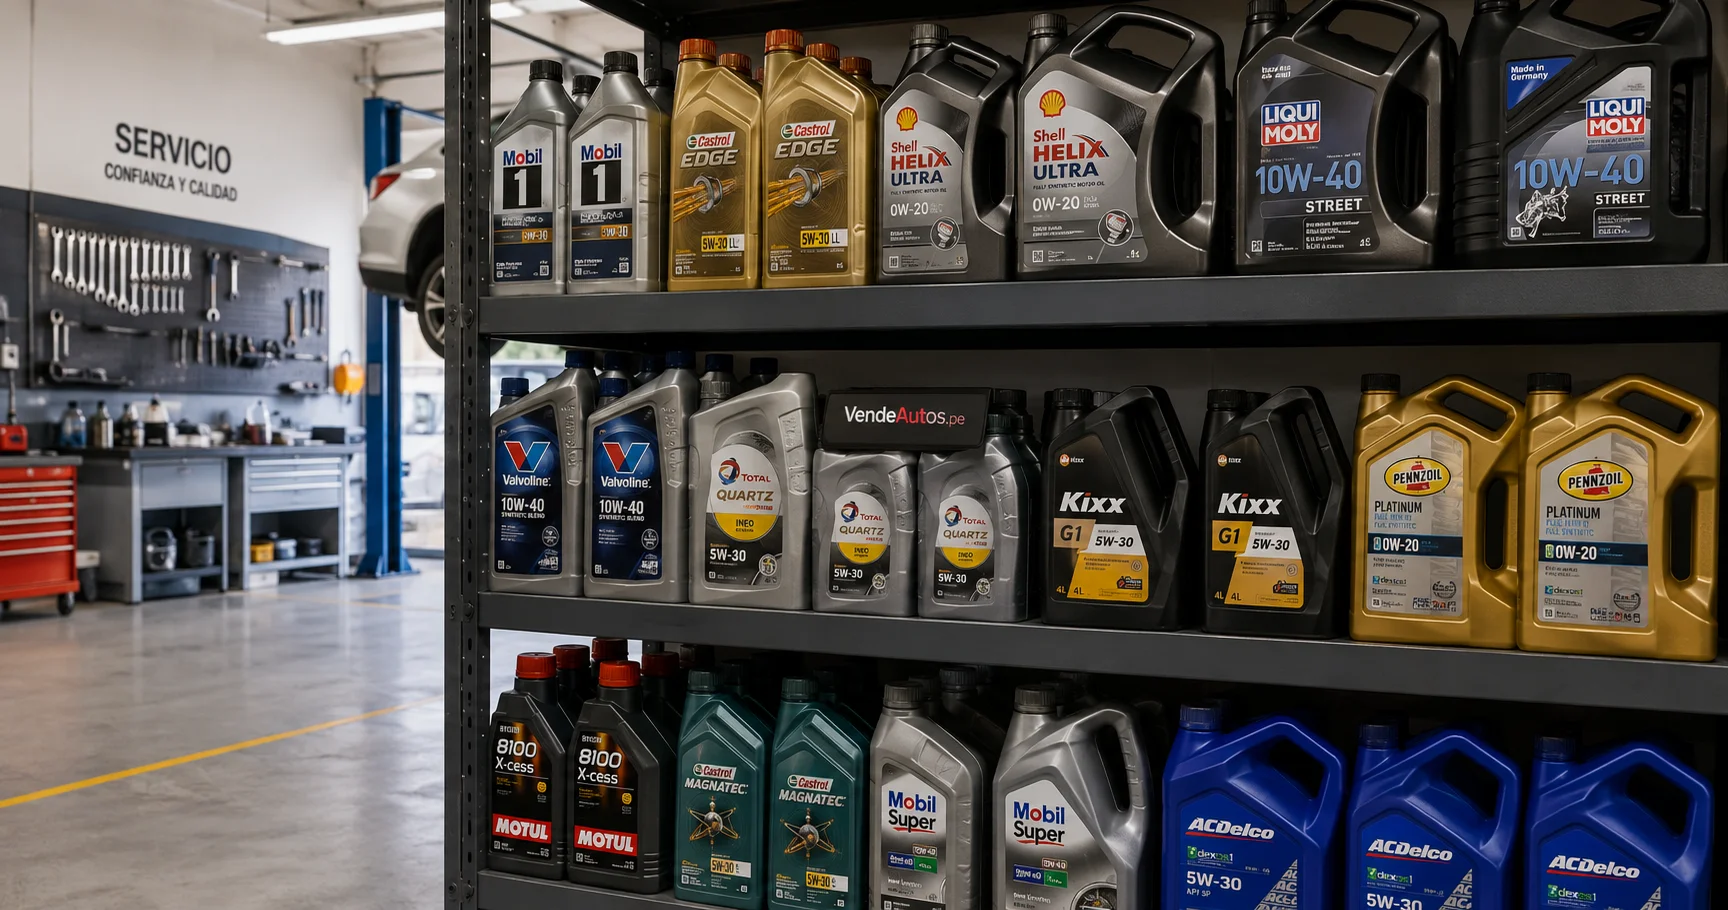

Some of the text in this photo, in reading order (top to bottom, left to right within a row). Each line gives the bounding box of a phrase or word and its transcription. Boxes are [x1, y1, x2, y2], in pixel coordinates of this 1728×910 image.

[1265, 103, 1316, 123] LIQUI
[1590, 99, 1642, 117] LIQUI
[794, 123, 830, 137] Castrol
[1265, 123, 1318, 143] MOLY
[1590, 117, 1643, 135] MOLY
[697, 133, 731, 146] Castrol
[1034, 128, 1065, 142] Shell
[116, 122, 231, 174] SERVICIO
[581, 143, 621, 160] Mobil
[775, 139, 840, 158] EDGE
[892, 140, 917, 153] Shell
[1033, 140, 1107, 162] HELIX
[503, 149, 542, 166] Mobil
[680, 150, 739, 168] EDGE
[892, 150, 951, 170] HELIX
[892, 170, 943, 186] ULTRA
[1033, 162, 1099, 180] ULTRA
[1255, 160, 1362, 194] 10W-40
[1514, 153, 1644, 189] 10W-40
[105, 162, 237, 202] CONFIANZA Y CALIDAD
[514, 169, 526, 206] 1
[593, 164, 605, 202] 1
[1033, 196, 1079, 211] 0W-20
[1306, 198, 1362, 213] STREET
[1596, 193, 1645, 205] STREET
[890, 202, 928, 216] 0W-20
[802, 232, 840, 245] 5W-30 LL
[844, 406, 965, 427] VendeAutos.pe
[503, 474, 549, 486] Valvoline
[601, 476, 649, 488] Valvoline
[741, 474, 771, 482] TOTAL
[1393, 468, 1442, 485] PENNZOIL
[1568, 472, 1623, 489] PENNZOIL
[717, 489, 774, 501] QUARTZ
[1059, 492, 1126, 513] Kixx
[501, 498, 544, 512] 10W-40
[599, 500, 644, 514] 10W-40
[1217, 493, 1282, 515] Kixx
[1375, 501, 1422, 513] PLATINUM
[860, 513, 882, 521] TOTAL
[1547, 506, 1600, 519] PLATINUM
[736, 519, 754, 527] INEO
[840, 526, 884, 535] QUARTZ
[943, 529, 988, 539] QUARTZ
[1060, 525, 1081, 541] G1
[1219, 527, 1241, 544] G1
[1095, 536, 1133, 547] 5W-30
[1252, 539, 1290, 550] 5W-30
[1383, 537, 1419, 552] 0W-20
[710, 548, 746, 561] 5W-30
[1556, 545, 1597, 560] 0W-20
[834, 569, 862, 578] 5W-30
[938, 573, 967, 583] 5W-30
[1056, 586, 1066, 594] 4L
[1073, 587, 1084, 595] 4L
[1215, 591, 1224, 599] 4L
[1231, 592, 1241, 601] 4L
[497, 739, 537, 758] 8100
[495, 756, 534, 773] X-cess
[579, 749, 621, 768] 8100
[578, 767, 618, 784] X-cess
[704, 766, 732, 778] Castrol
[685, 778, 745, 794] MAGNATEC
[798, 777, 828, 790] Castrol
[779, 789, 842, 806] MAGNATEC
[889, 791, 936, 812] Mobil
[889, 809, 936, 833] Super
[1014, 802, 1065, 824] Mobil
[496, 818, 548, 840] MOTUL
[1014, 821, 1065, 845] Super
[1188, 817, 1274, 840] ACDelco
[578, 830, 633, 852] MOTUL
[1368, 839, 1453, 861] ACDelco
[712, 860, 734, 873] 5W-30
[1549, 855, 1640, 878] ACDelco
[807, 873, 830, 887] 5W-30
[1186, 871, 1242, 890] 5W-30
[1367, 893, 1422, 910] 5W-30
